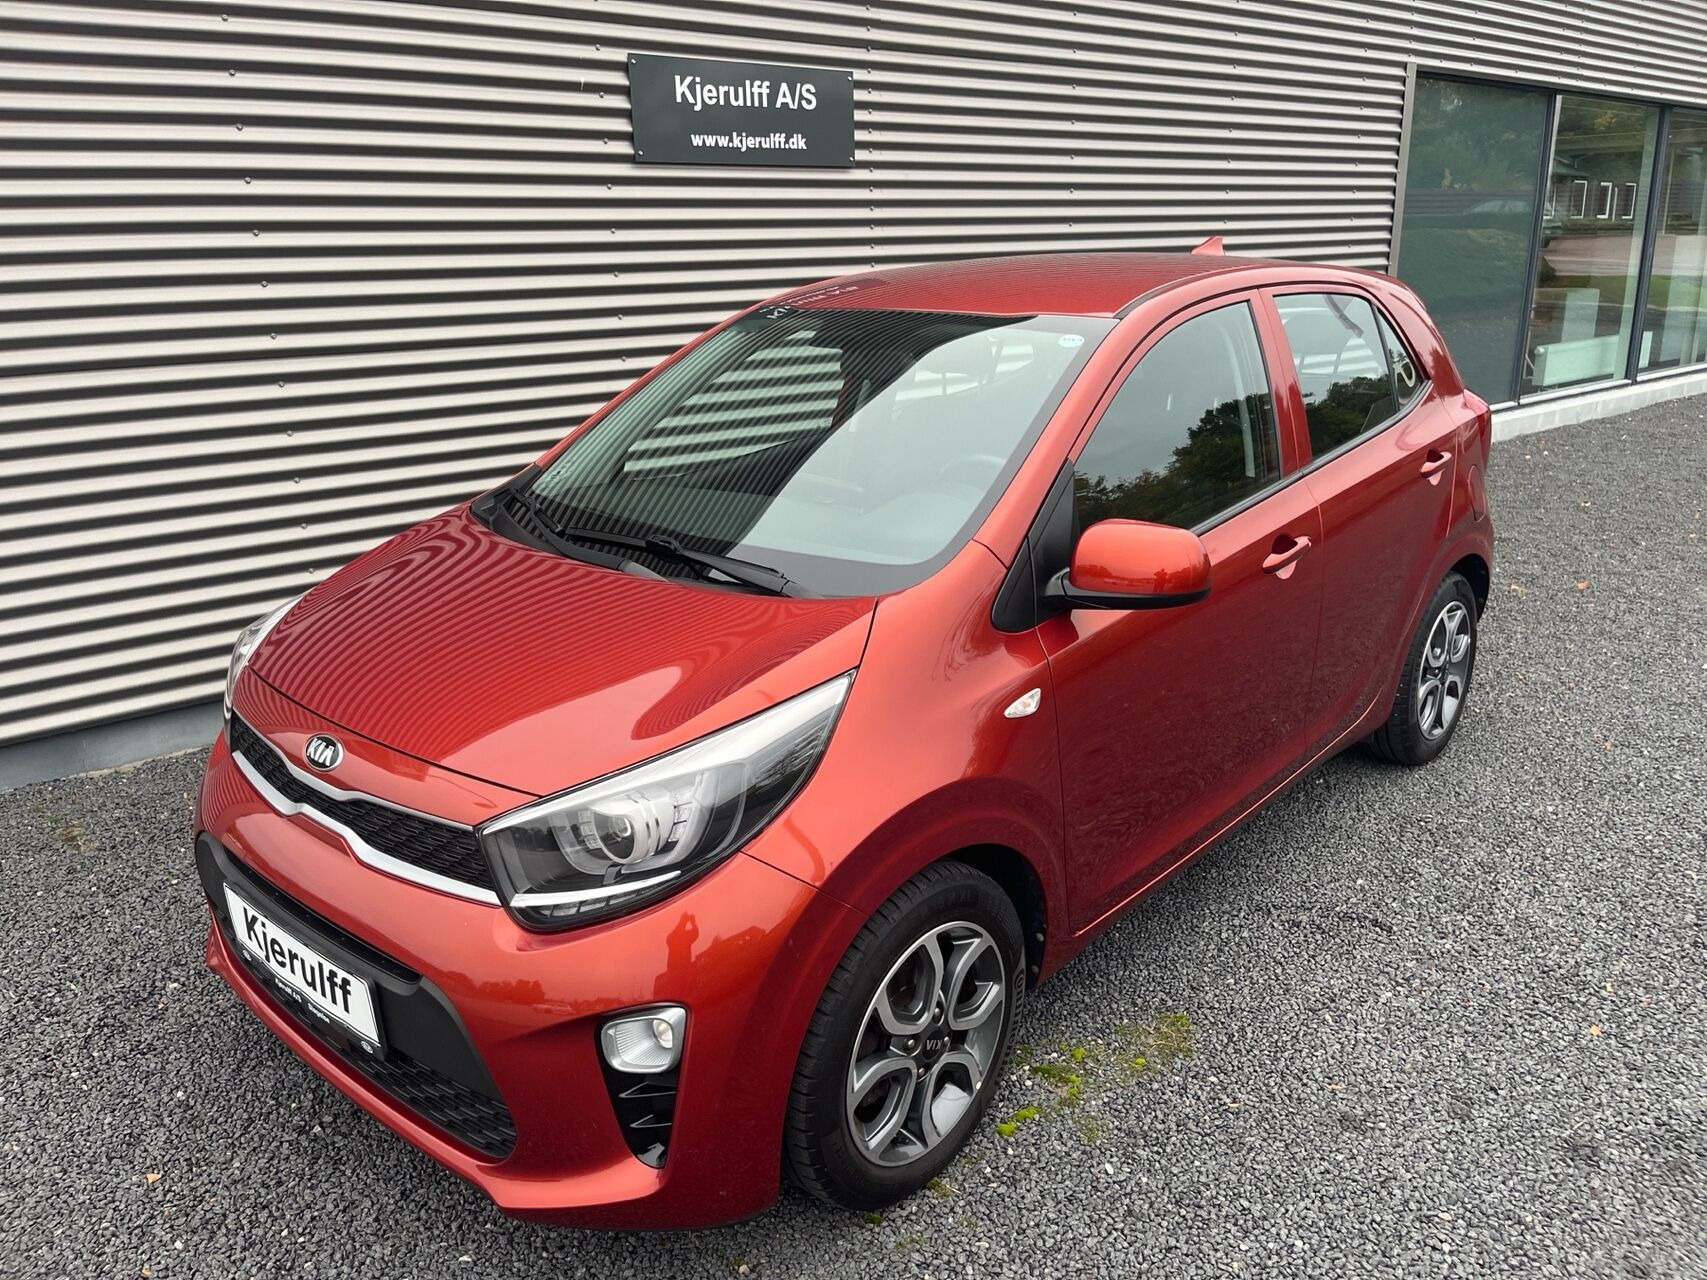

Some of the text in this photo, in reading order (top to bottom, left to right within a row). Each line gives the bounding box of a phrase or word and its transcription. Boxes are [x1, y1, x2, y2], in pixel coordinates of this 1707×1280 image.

[674, 75, 817, 111] Kjerulff A/S
[691, 131, 807, 152] www.kjerulff.dk
[306, 738, 334, 766] KIA
[243, 906, 352, 1014] Kjerulff
